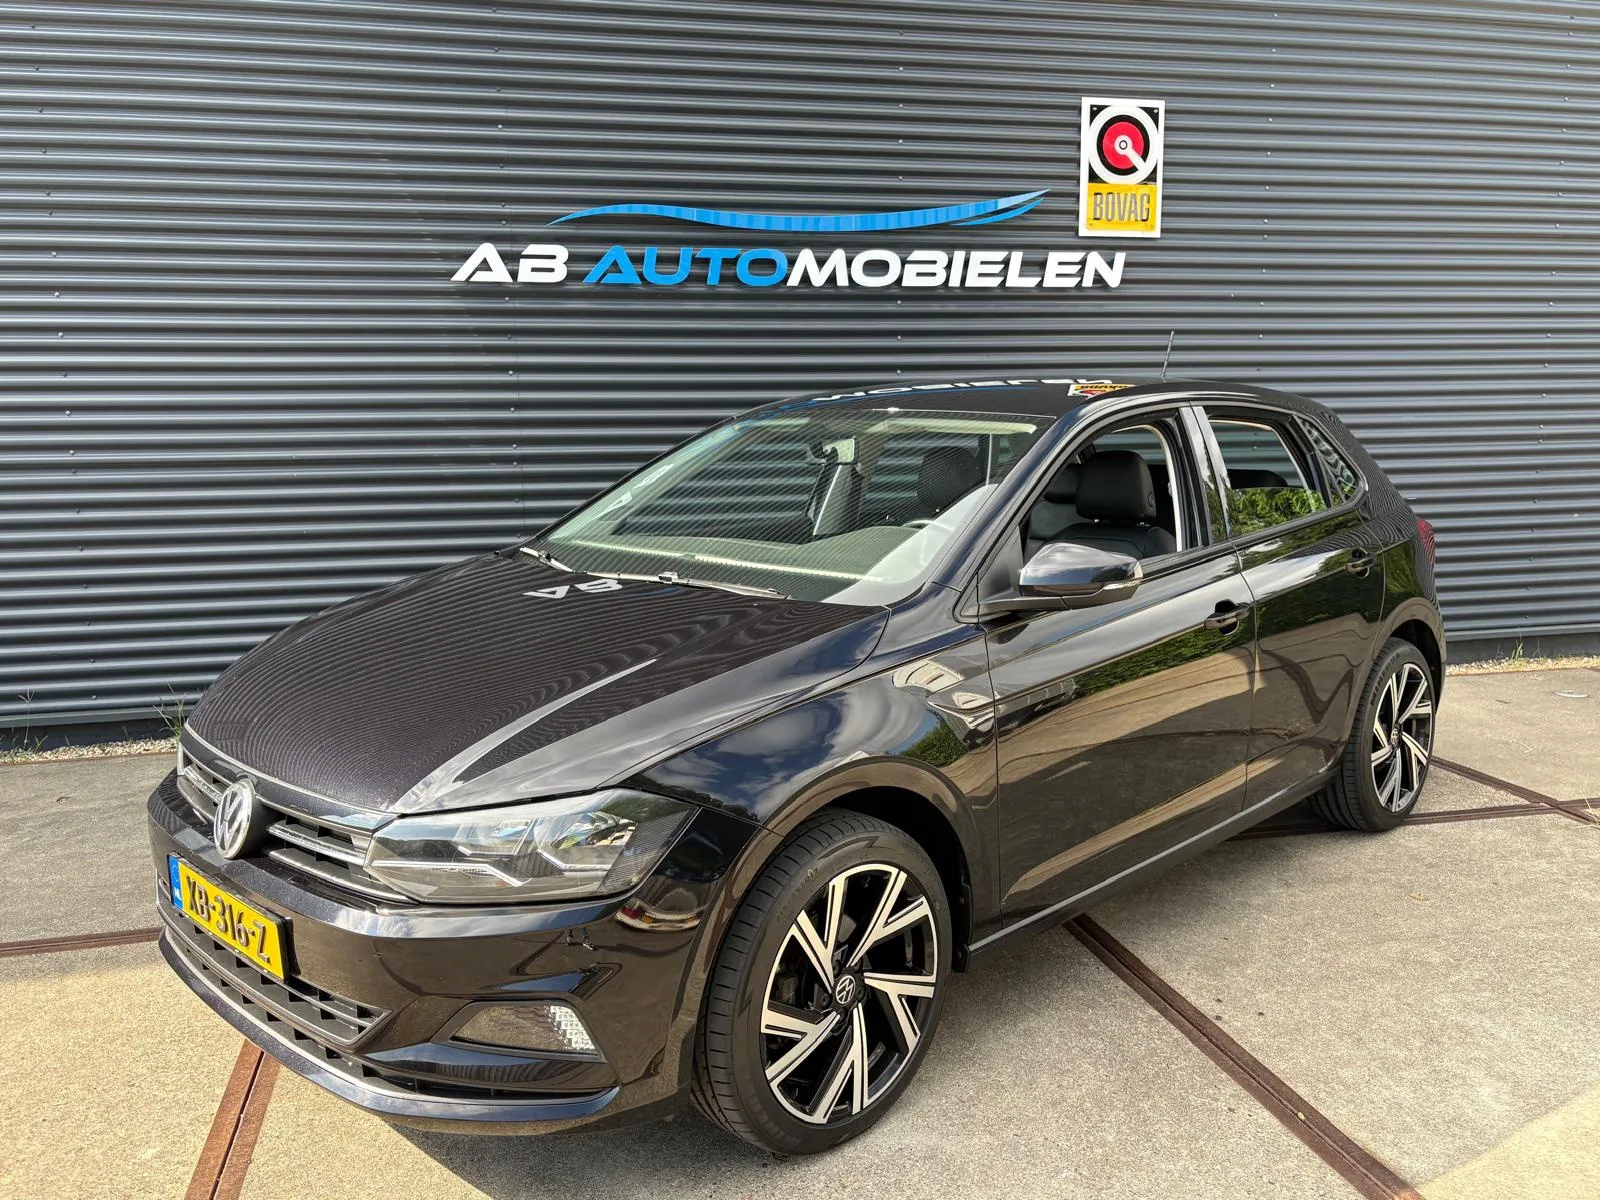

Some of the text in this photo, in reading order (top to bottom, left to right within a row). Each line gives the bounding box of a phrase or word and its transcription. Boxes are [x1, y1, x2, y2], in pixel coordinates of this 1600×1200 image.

[1092, 191, 1151, 223] BOVAG
[450, 242, 1127, 289] AB AUTOMOBIELEN
[186, 875, 272, 966] XB-316-Z
